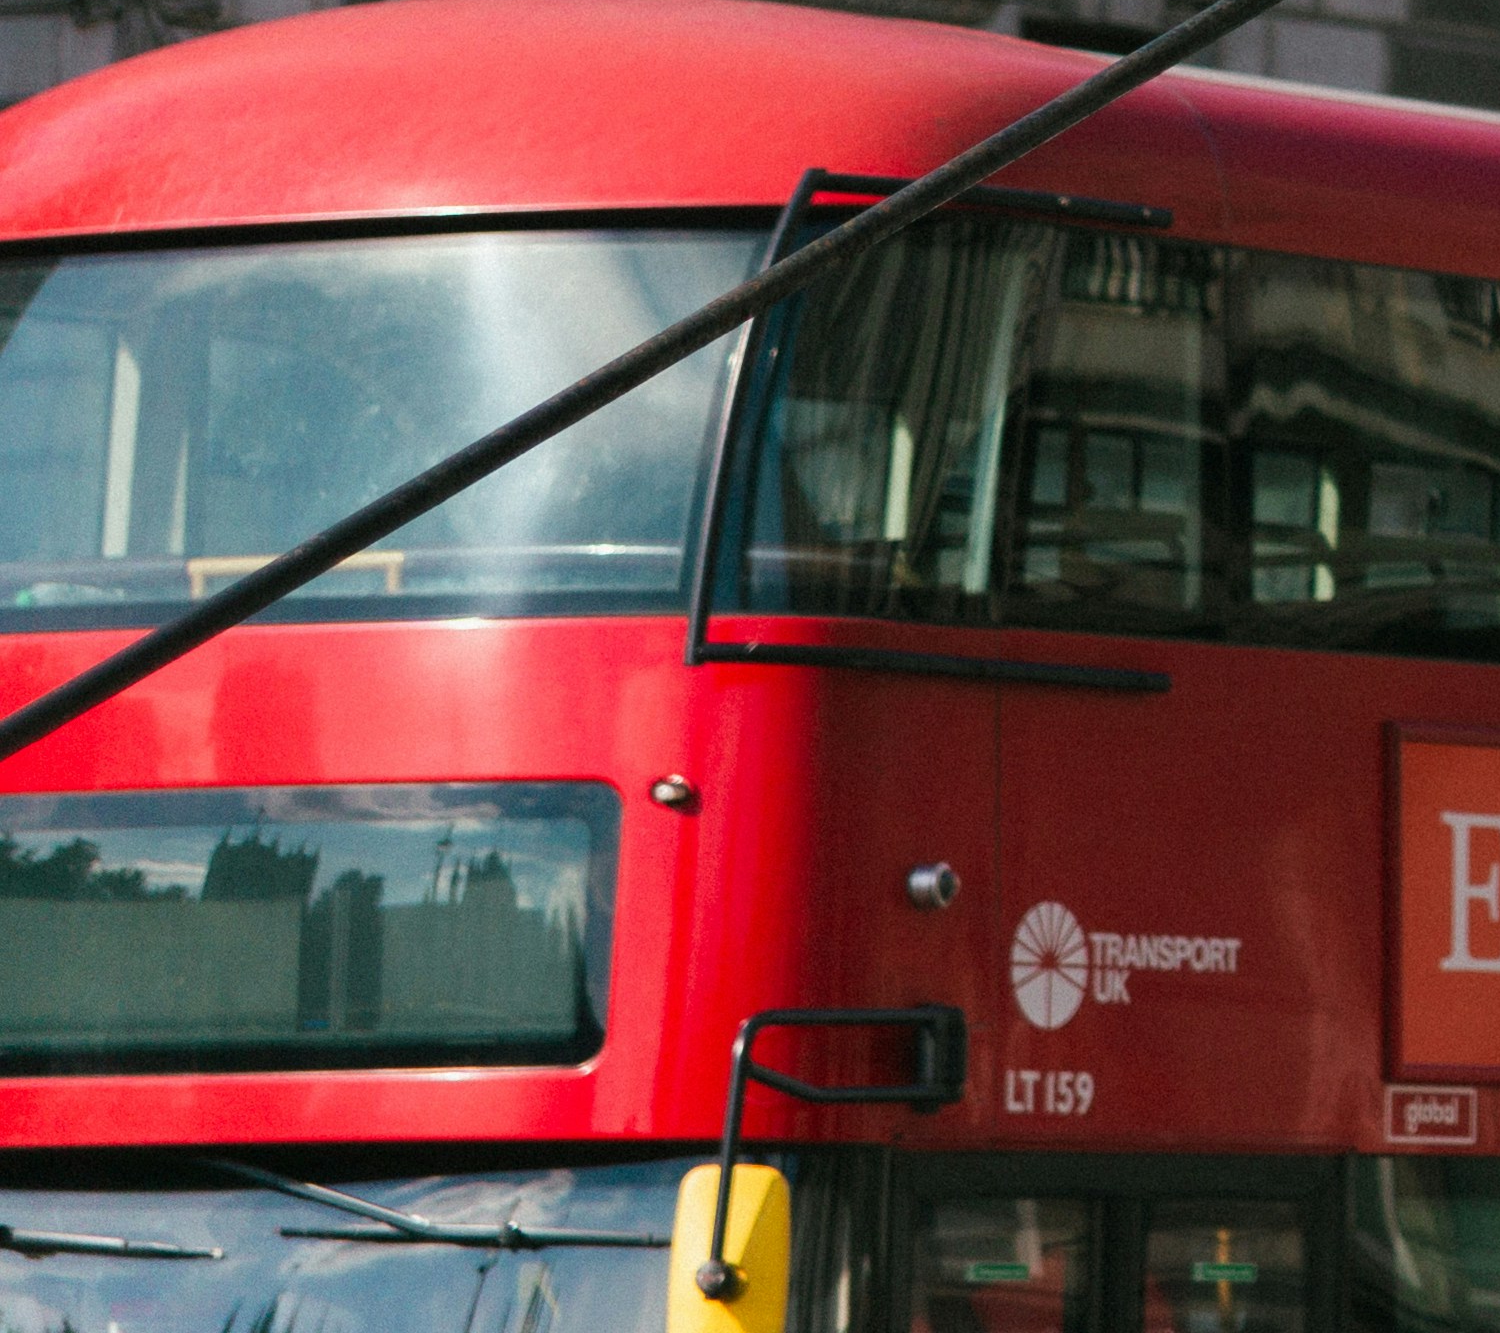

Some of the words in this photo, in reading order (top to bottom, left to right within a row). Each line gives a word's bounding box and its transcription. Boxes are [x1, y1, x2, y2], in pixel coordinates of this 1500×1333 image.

[1089, 932, 1241, 973] TRANSPORT
[1092, 969, 1131, 1004] UK
[1004, 1067, 1042, 1115] LT
[1043, 1070, 1096, 1116] 159
